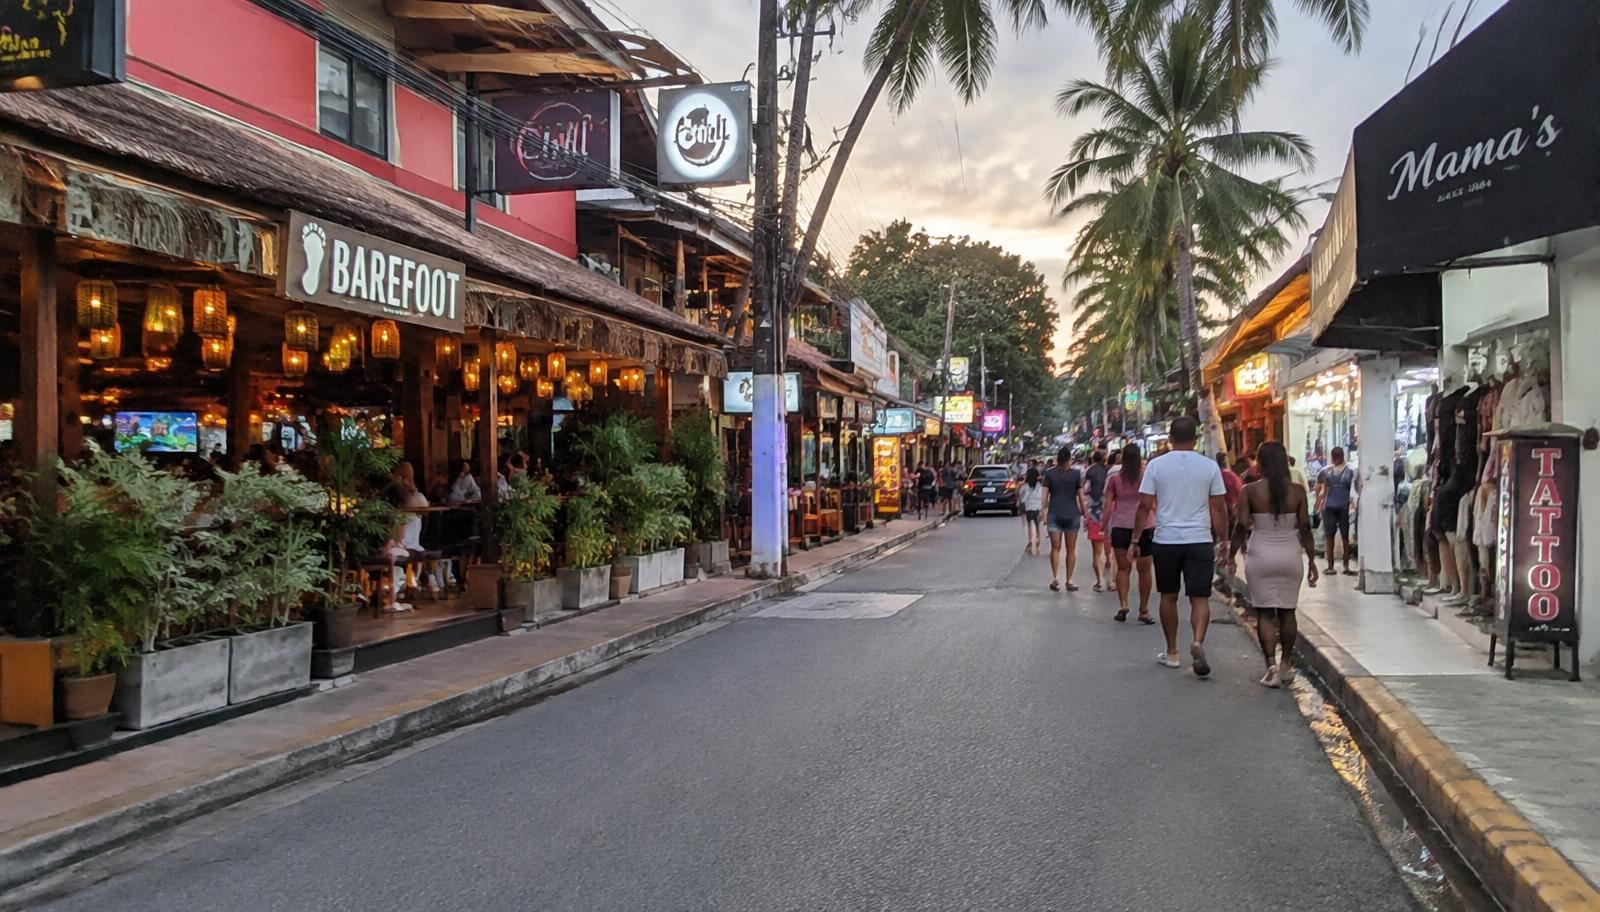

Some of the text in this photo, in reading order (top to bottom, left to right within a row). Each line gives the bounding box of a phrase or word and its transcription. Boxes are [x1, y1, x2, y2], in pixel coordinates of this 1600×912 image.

[1387, 104, 1564, 201] Mama's
[330, 239, 460, 319] BAREFOOT
[1527, 447, 1562, 621] TATTOO
